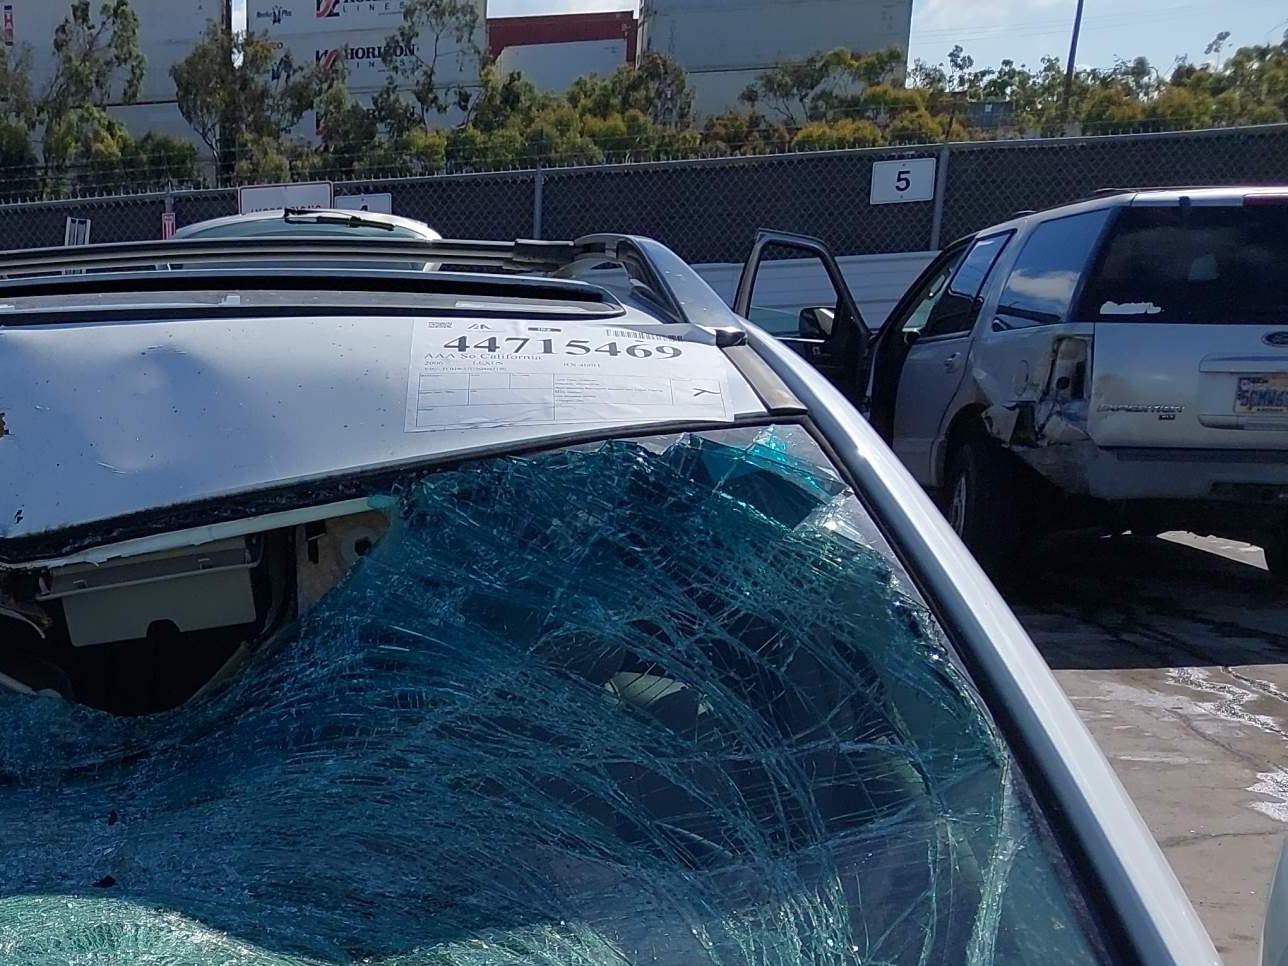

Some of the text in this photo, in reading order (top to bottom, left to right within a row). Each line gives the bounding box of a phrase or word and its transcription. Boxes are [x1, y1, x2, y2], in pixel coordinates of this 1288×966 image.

[342, 1, 406, 14] LINES
[346, 43, 416, 61] HORION
[895, 170, 911, 193] 5
[424, 352, 456, 360] AAA
[481, 352, 543, 361] California
[443, 335, 684, 360] 44715469
